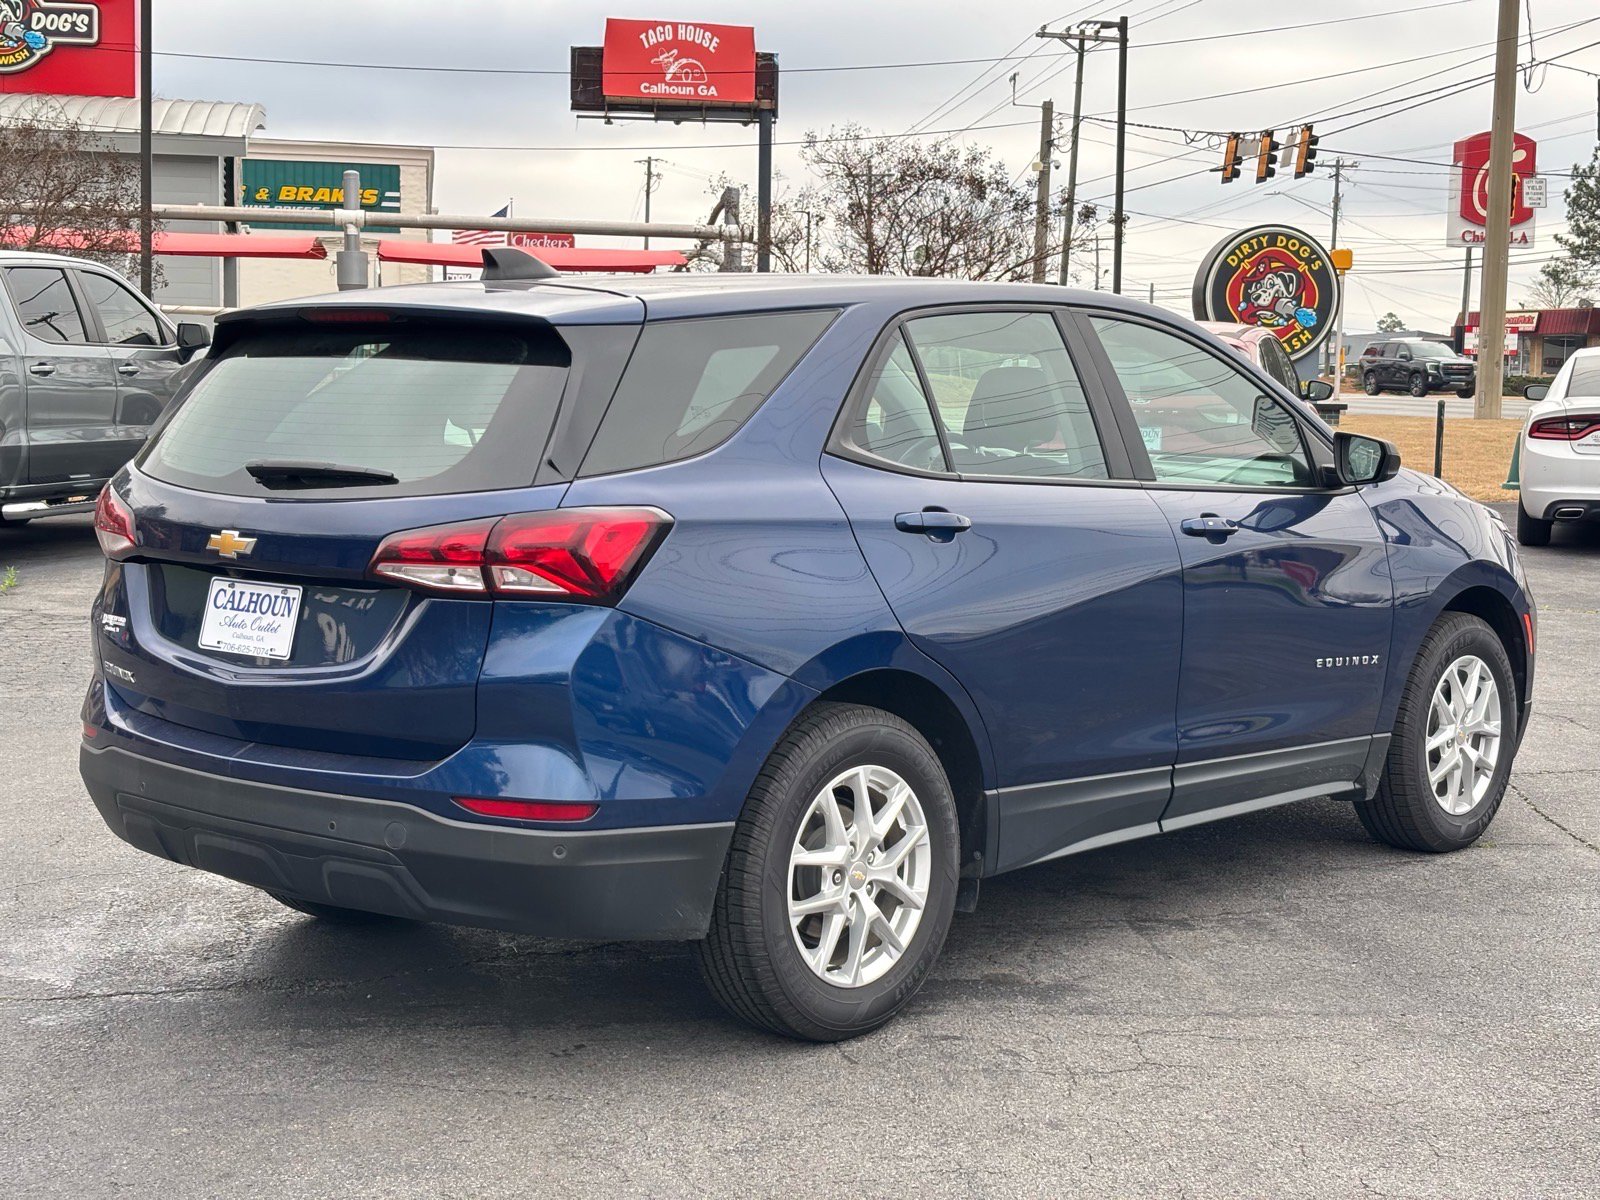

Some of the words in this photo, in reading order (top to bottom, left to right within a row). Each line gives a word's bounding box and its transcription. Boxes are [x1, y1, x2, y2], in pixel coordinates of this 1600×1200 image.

[31, 12, 89, 32] DOG'S
[640, 24, 673, 48] TACO
[678, 24, 719, 53] HOUSE
[640, 83, 694, 95] Calhoun
[697, 85, 718, 96] GA
[512, 235, 570, 248] Checkers
[1226, 236, 1268, 267] DIRTY
[1276, 235, 1323, 271] DOG'S
[213, 588, 296, 618] CALHOUN
[219, 614, 247, 630] Auto
[250, 616, 281, 634] Outlet
[222, 642, 269, 656] 706-625-7074
[1316, 655, 1379, 668] EQUINOX
